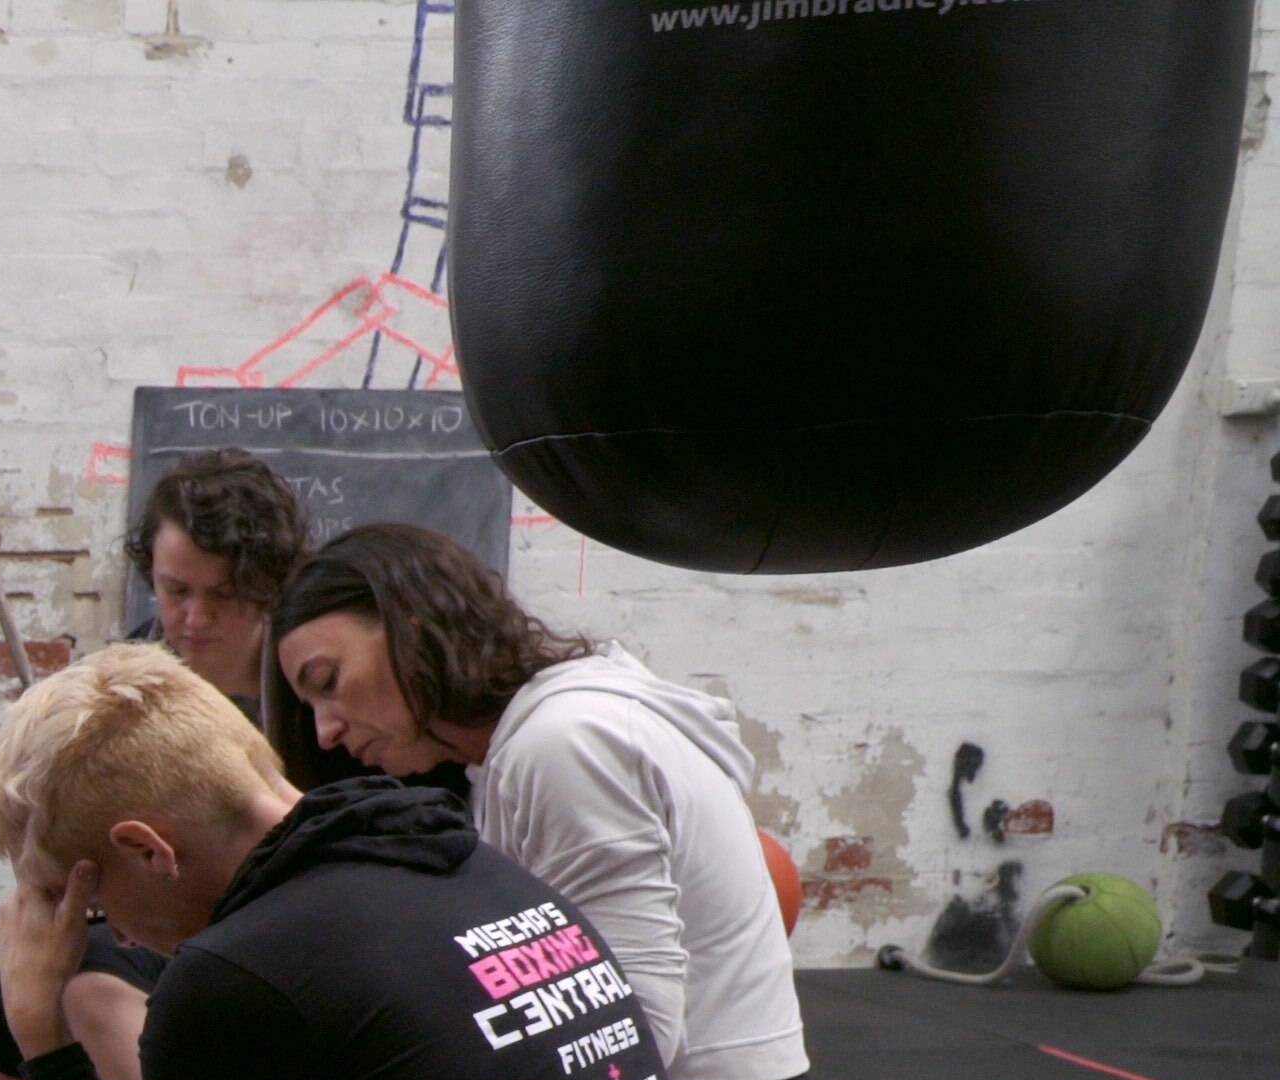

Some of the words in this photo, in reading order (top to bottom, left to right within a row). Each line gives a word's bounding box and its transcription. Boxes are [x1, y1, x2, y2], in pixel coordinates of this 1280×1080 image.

[652, 0, 1040, 32] www.jimbray.
[174, 400, 294, 430] TON-UP
[454, 902, 568, 958] MISCHA'S
[468, 924, 600, 999] BOXING
[557, 1017, 640, 1075] FITNESS
